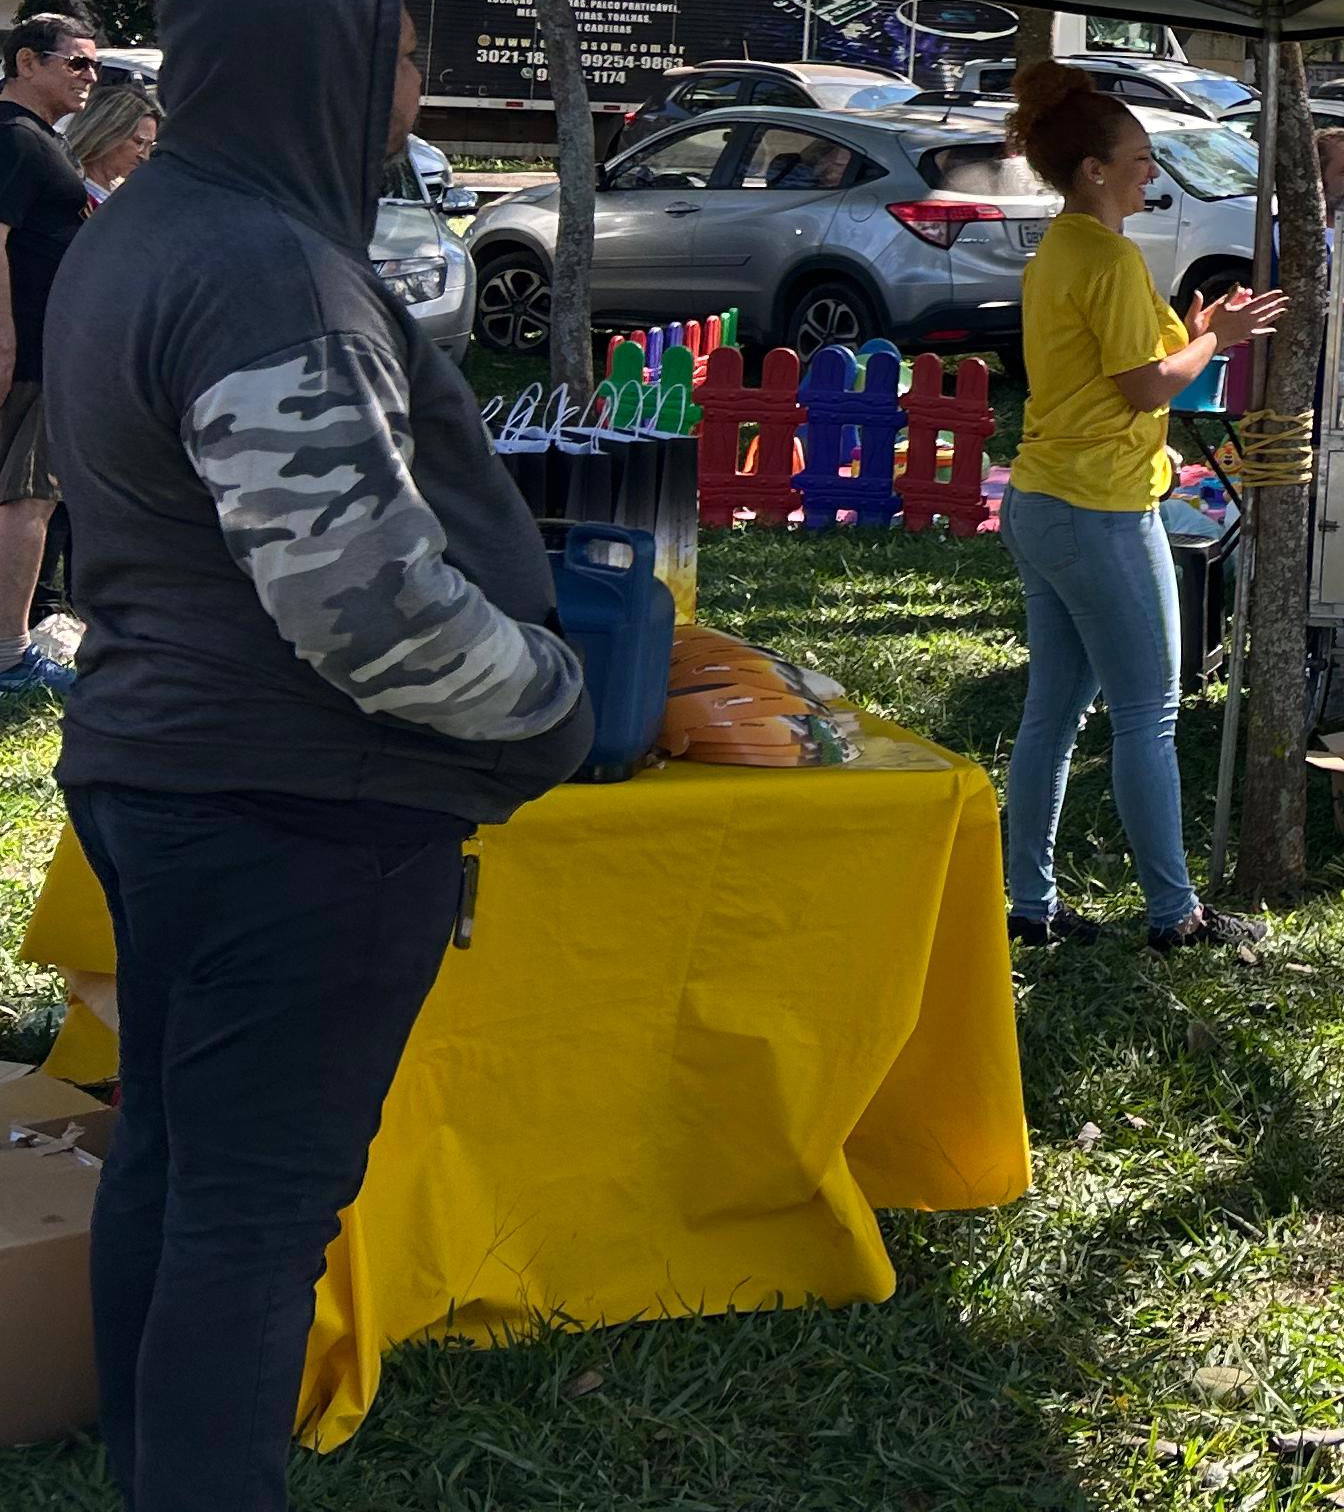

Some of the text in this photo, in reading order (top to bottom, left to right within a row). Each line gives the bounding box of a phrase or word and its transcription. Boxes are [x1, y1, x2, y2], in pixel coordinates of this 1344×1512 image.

[589, 0, 621, 10] PALCO
[583, 24, 632, 35] CADEIRAS
[476, 49, 549, 65] 3021-18
